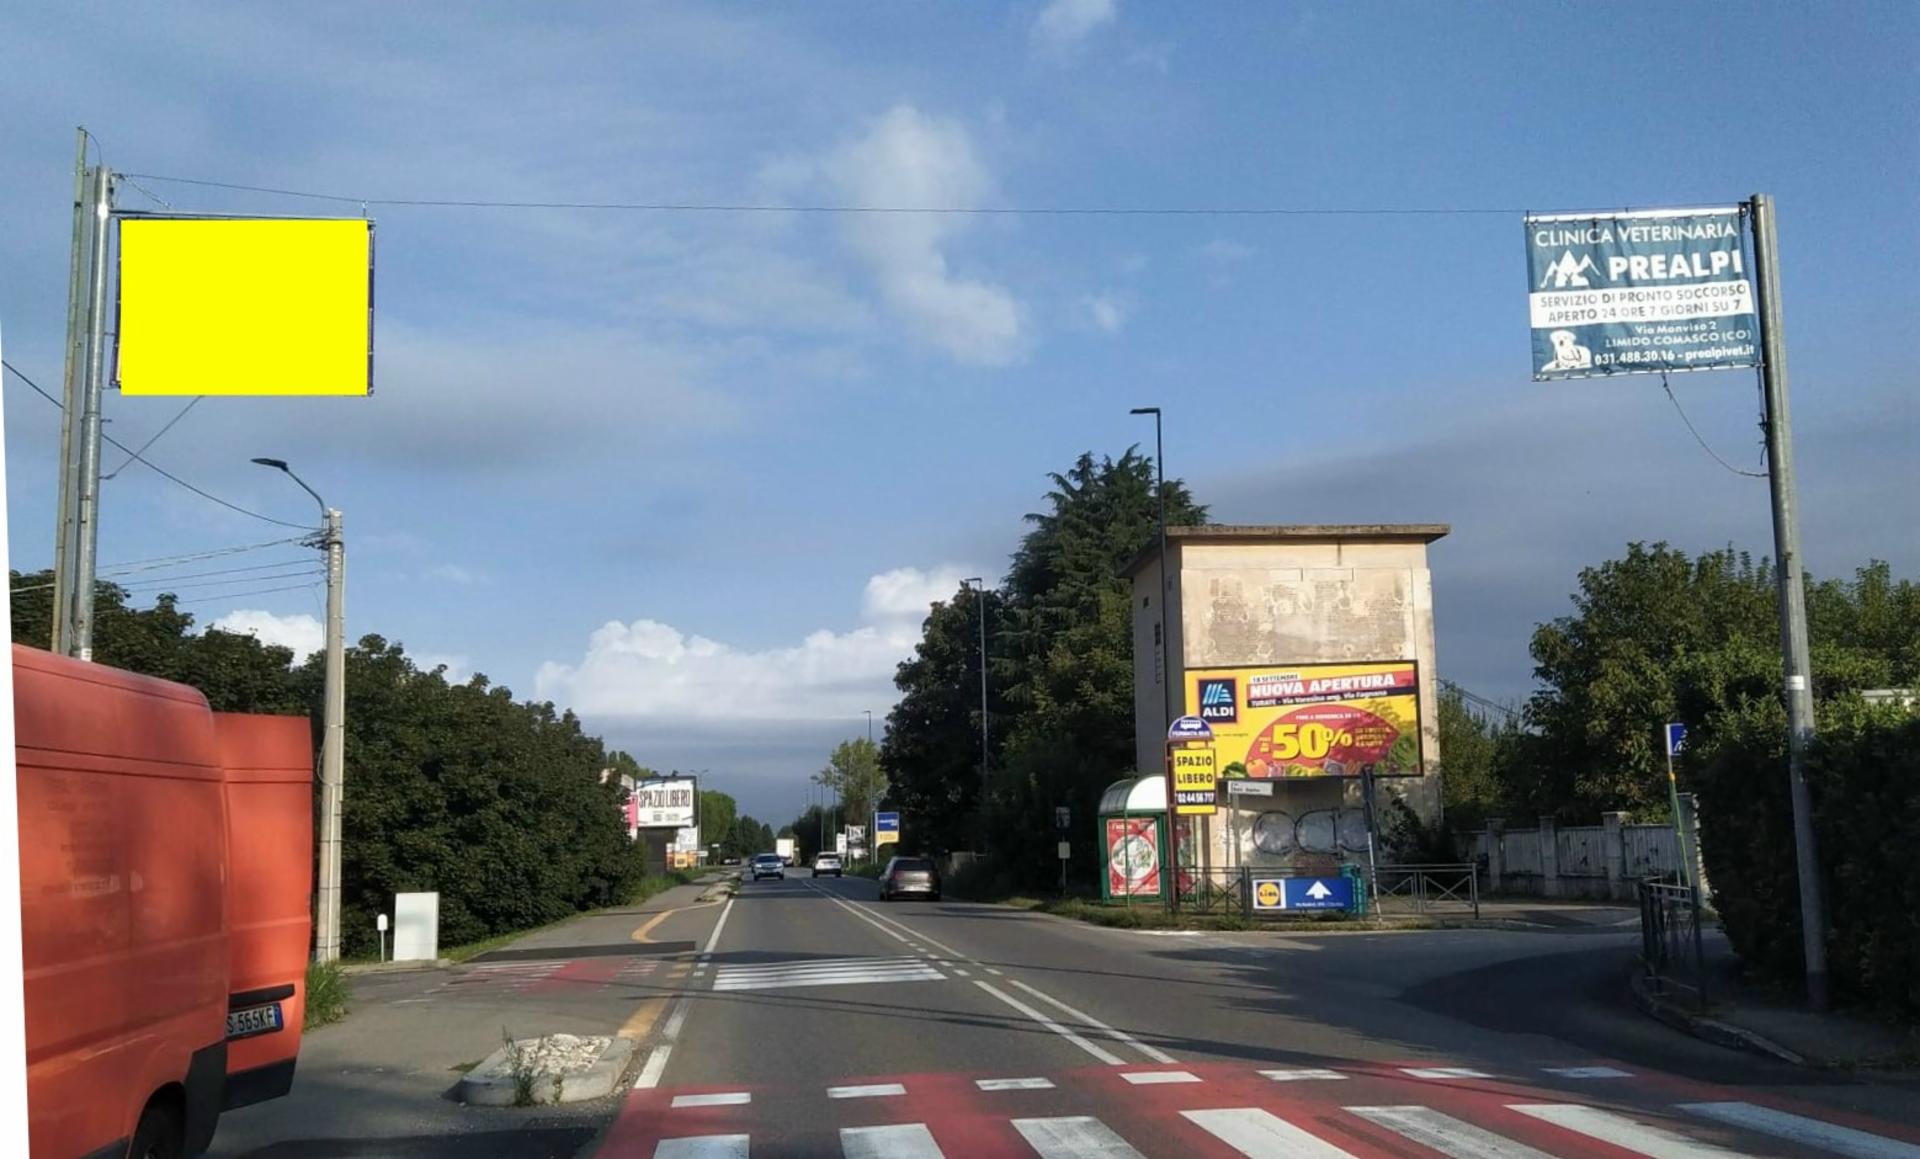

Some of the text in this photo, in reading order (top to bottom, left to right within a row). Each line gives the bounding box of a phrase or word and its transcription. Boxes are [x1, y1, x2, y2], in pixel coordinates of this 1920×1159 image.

[1535, 222, 1737, 247] CLINICA VETERINARIA
[1608, 249, 1743, 281] PREALPI
[1540, 284, 1747, 309] SERVIZIO DI PRONTO SOCCORSO
[1548, 299, 1742, 323] APERTO 24 ORE 7 GIORNI SU 7
[1634, 324, 1656, 335] Via
[1709, 321, 1717, 331] 2
[1605, 329, 1752, 348] LIMIDO COMASCO (CO)
[1250, 673, 1396, 698] NUOVA APERTURA
[1202, 706, 1235, 718] ALDI
[1176, 755, 1213, 767] SPAZIO
[1177, 773, 1214, 784] LIBERO
[639, 789, 691, 808] SPAZIO LIBERO
